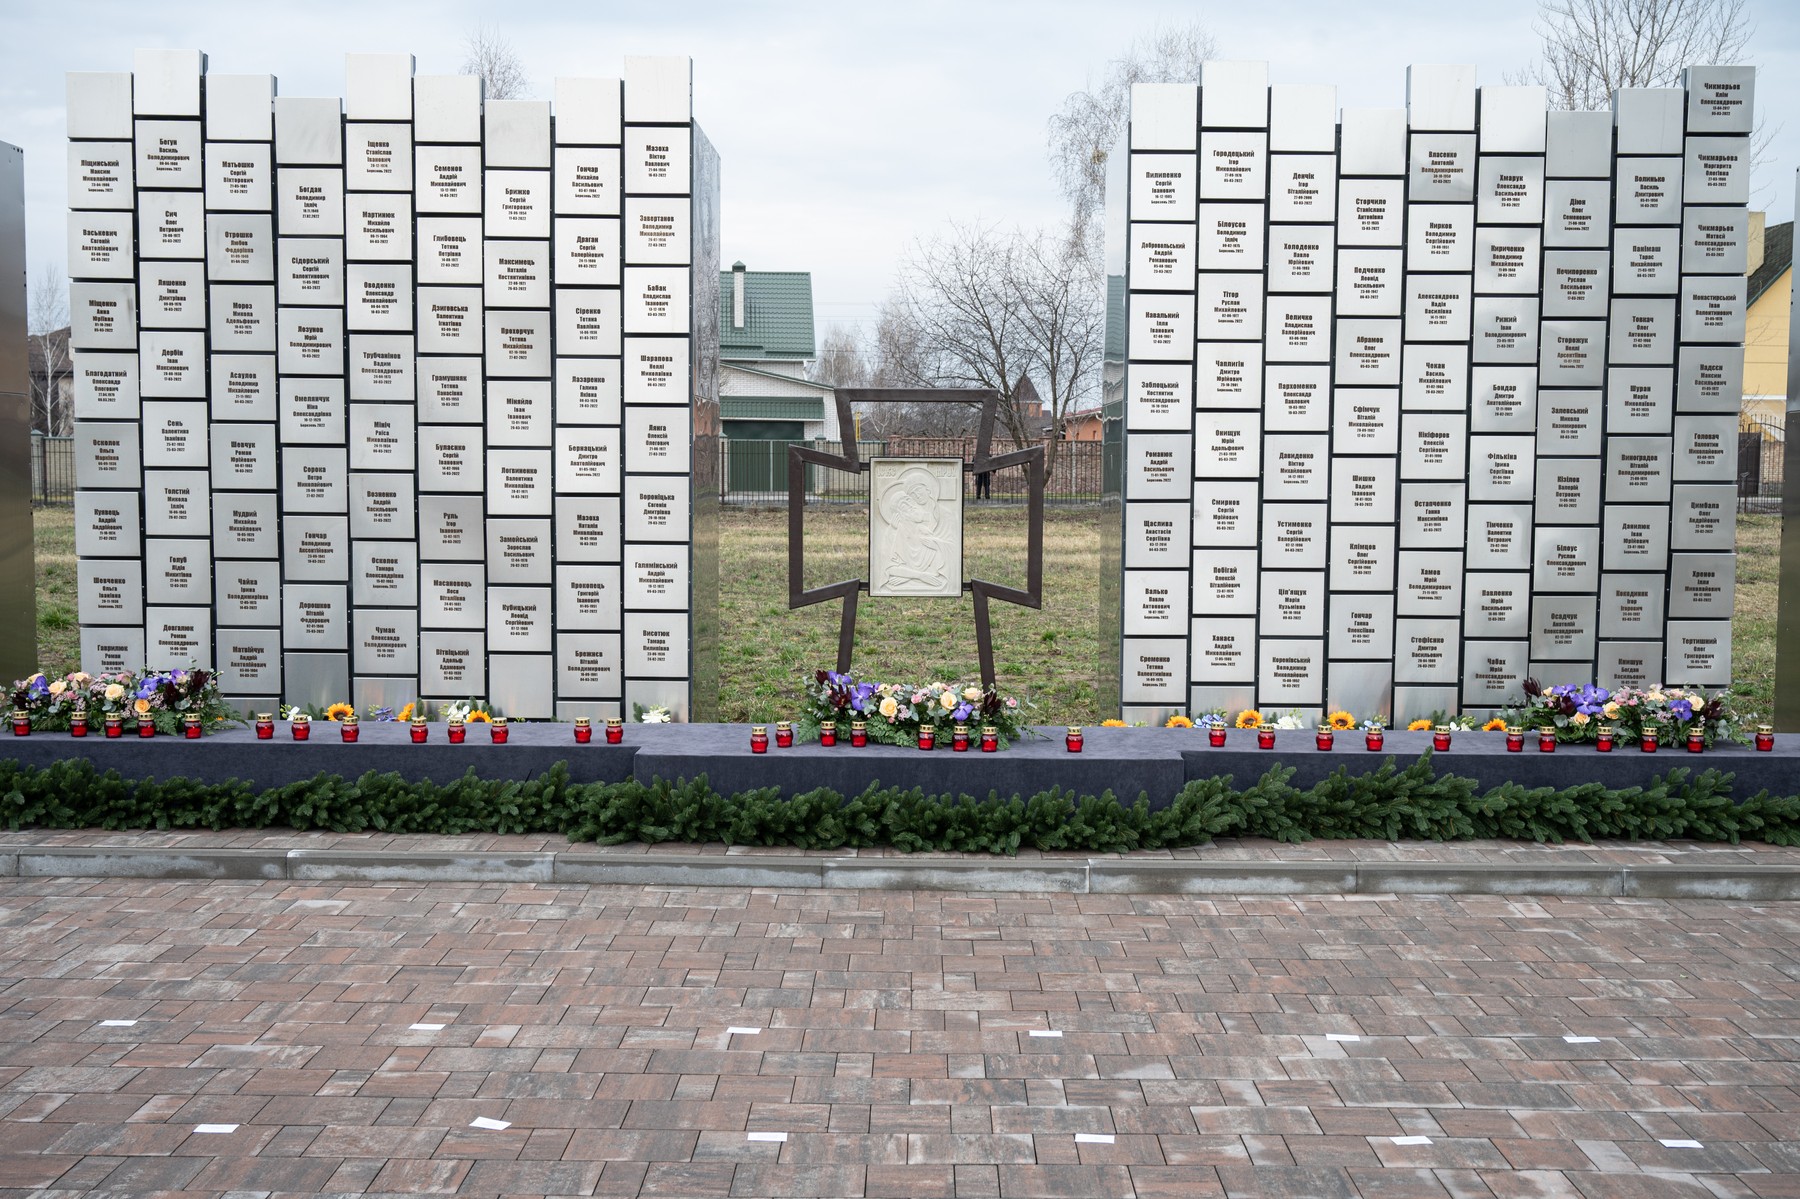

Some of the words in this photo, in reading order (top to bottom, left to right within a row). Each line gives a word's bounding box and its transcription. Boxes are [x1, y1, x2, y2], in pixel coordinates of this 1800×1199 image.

[1213, 150, 1254, 158] Городецький
[233, 510, 257, 518] Мудрий
[443, 512, 458, 520] Руль
